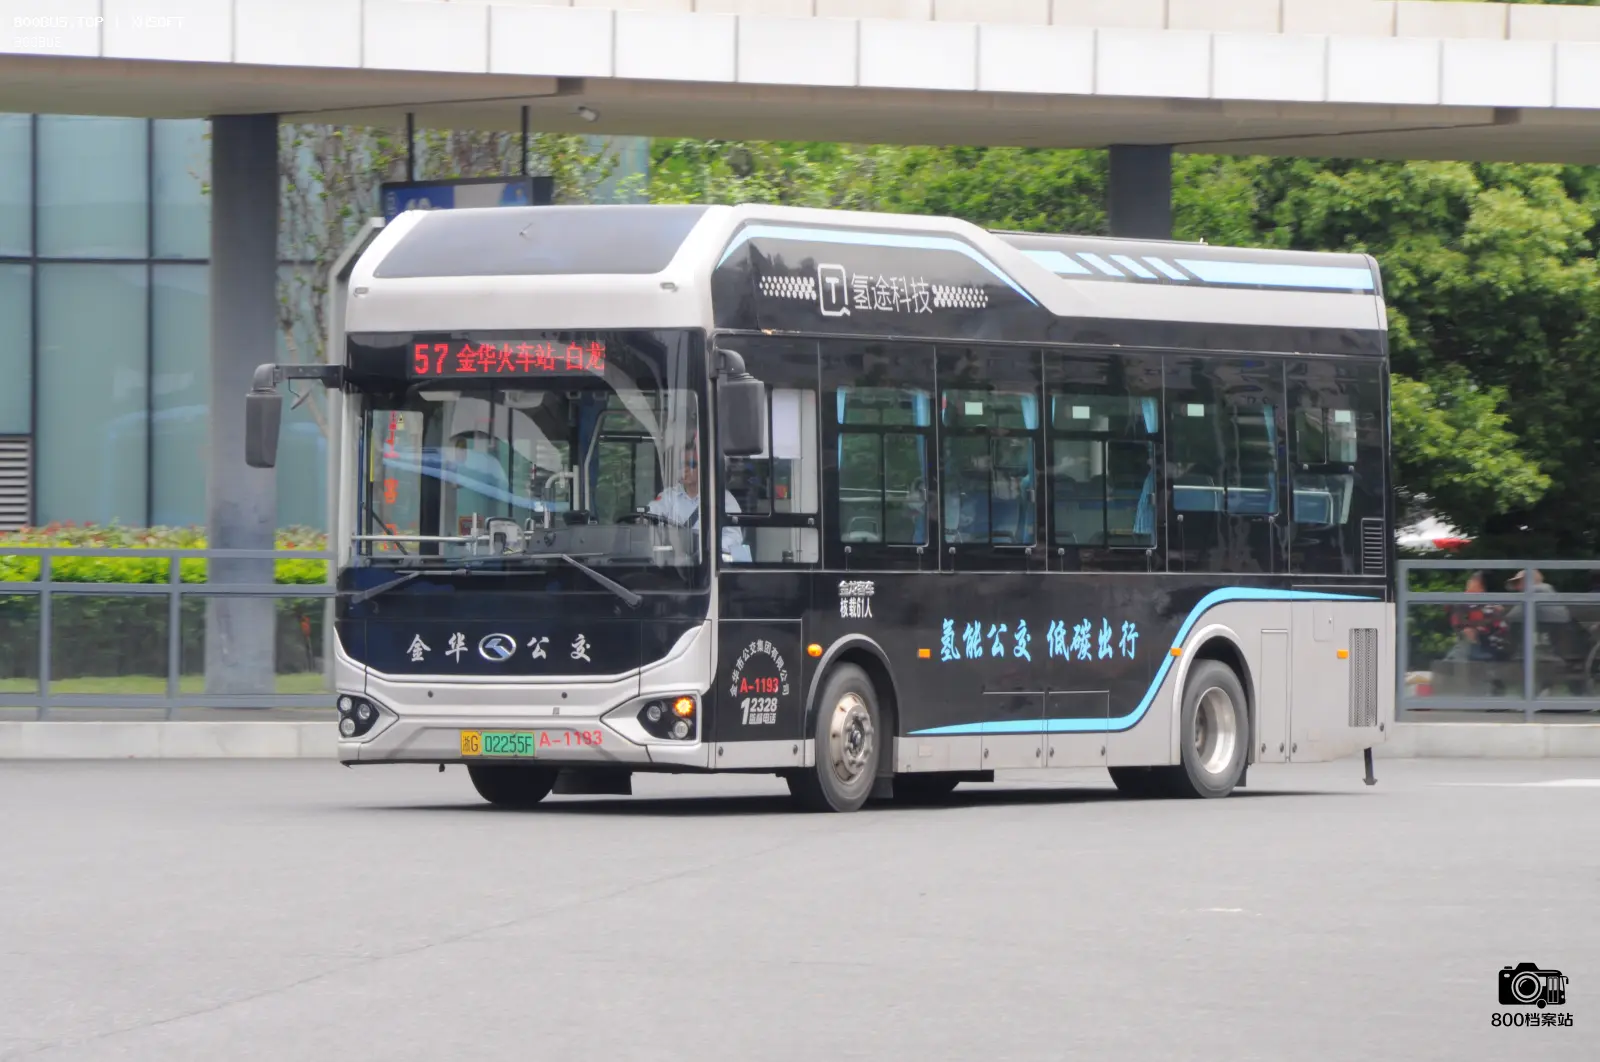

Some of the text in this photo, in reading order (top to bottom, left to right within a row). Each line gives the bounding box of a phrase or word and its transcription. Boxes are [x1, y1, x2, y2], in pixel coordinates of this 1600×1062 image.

[851, 273, 933, 314] 氢途科技
[414, 341, 606, 375] 57 金华火车站-白龙
[839, 597, 873, 618] 核载61人
[406, 632, 591, 663] 金华 公交
[941, 617, 1139, 662] 氢能公交 低碳出行
[730, 639, 790, 697] 金华市公交集团有限公司
[739, 677, 780, 694] A-1193
[740, 697, 778, 725] 12328
[462, 735, 534, 754] 浙G 02255F
[539, 729, 604, 748] A-1193
